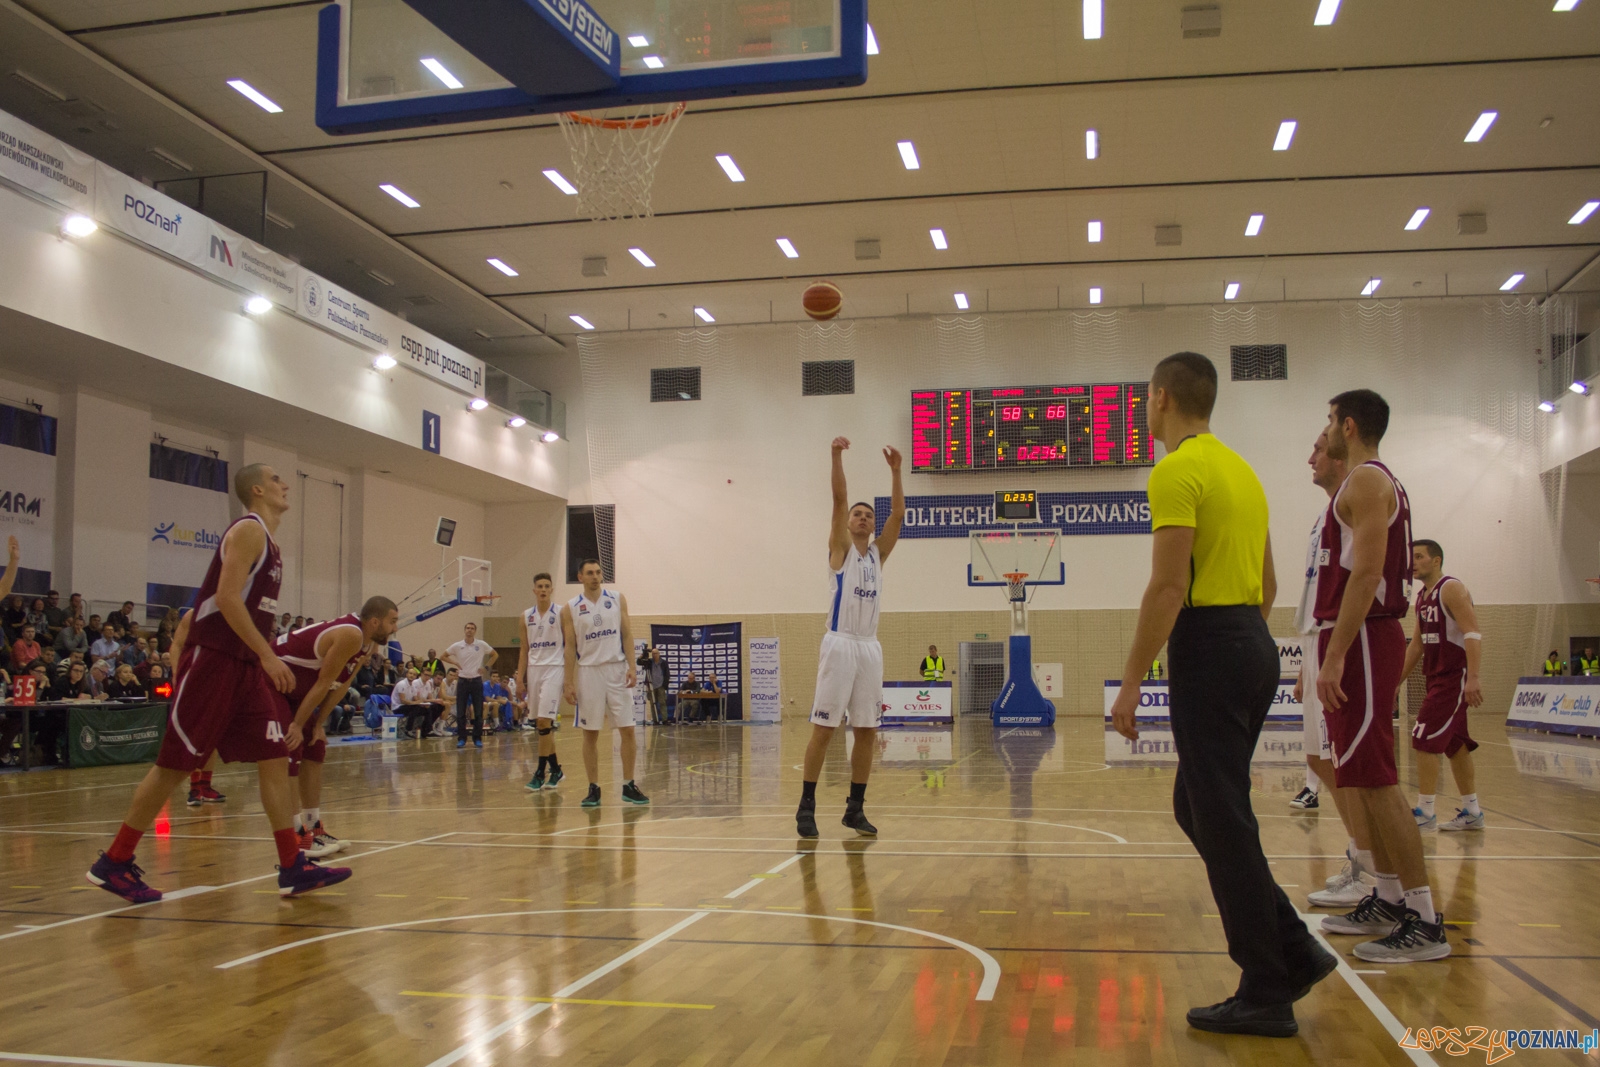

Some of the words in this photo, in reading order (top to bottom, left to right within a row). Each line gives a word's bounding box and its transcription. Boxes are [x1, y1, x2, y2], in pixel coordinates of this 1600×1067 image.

[0, 131, 17, 148] RZĄD
[328, 290, 351, 312] Centrum
[352, 302, 369, 322] Sportu
[401, 335, 482, 388] cspp.put.poznan.pl
[1002, 406, 1021, 421] 58
[1046, 405, 1066, 420] 66
[429, 417, 436, 449] 1
[1052, 499, 1150, 524] POZNAŃS
[593, 614, 603, 627] 8
[1426, 605, 1439, 622] 21
[904, 703, 942, 711] CYMES
